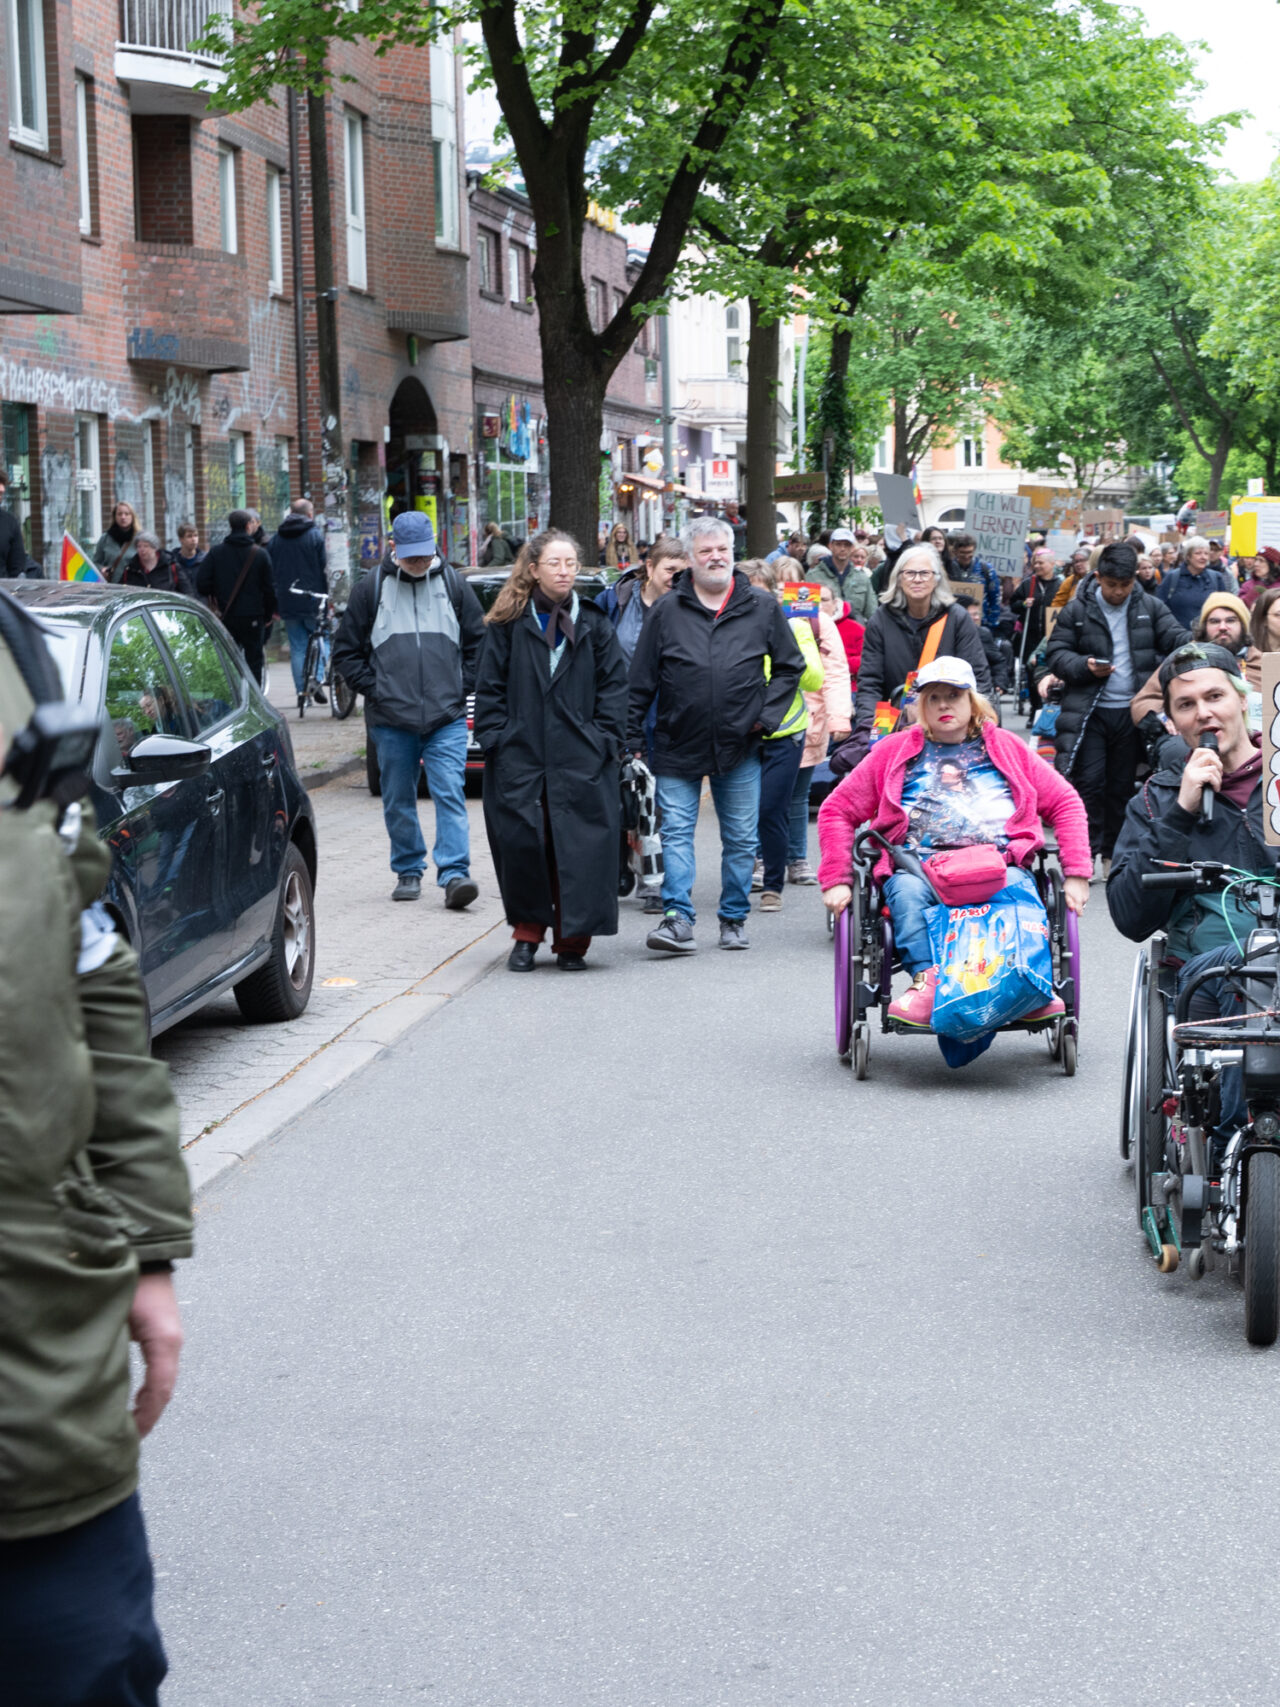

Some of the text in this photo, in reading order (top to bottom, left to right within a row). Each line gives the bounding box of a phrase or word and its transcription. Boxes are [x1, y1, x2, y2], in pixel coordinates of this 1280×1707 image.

[974, 493, 995, 511] ICH
[1001, 496, 1025, 514] WILL
[973, 513, 1022, 535] LERNEN
[978, 533, 1016, 554] NICHT
